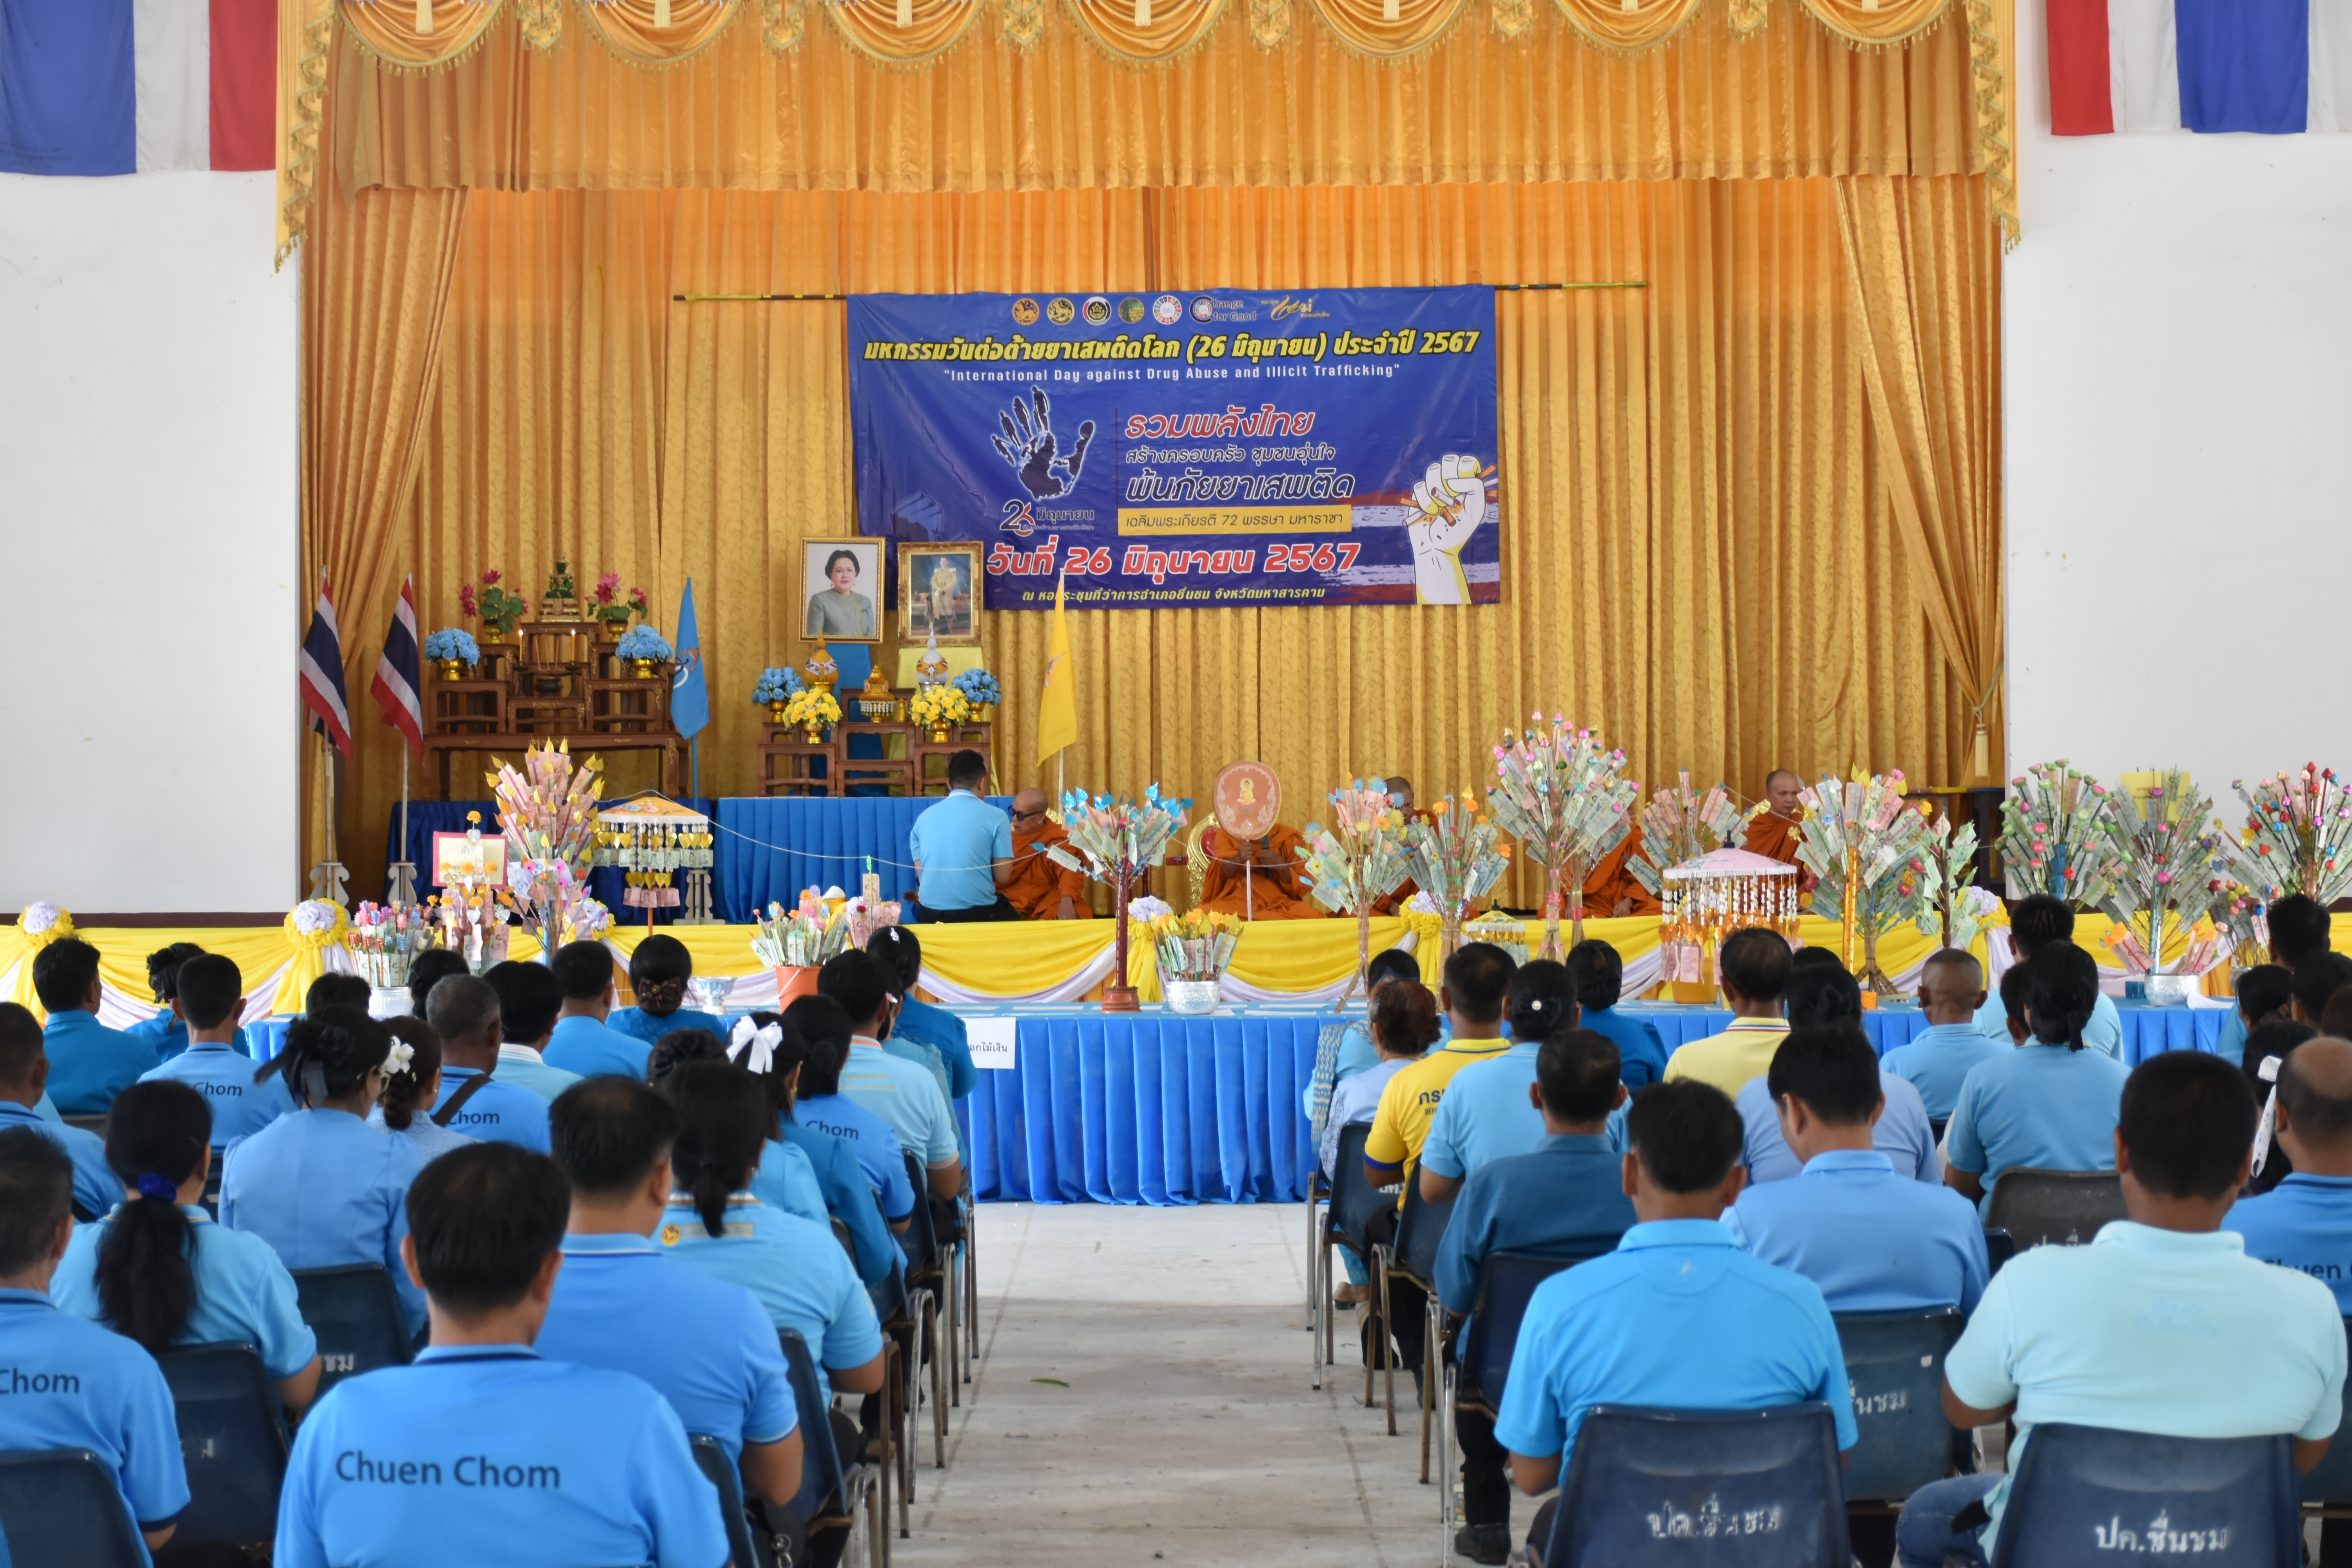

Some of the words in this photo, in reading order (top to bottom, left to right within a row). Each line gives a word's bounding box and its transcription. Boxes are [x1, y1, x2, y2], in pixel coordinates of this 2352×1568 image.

[1230, 311, 1256, 321] Good
[1187, 335, 1228, 364] (26
[1232, 332, 1327, 363] มิถุนายน)
[1334, 330, 1417, 355] ประจำปี
[1419, 331, 1481, 353] 2567
[944, 370, 1047, 381] "International
[1055, 370, 1079, 382] Day
[1087, 370, 1140, 382] against
[1147, 368, 1179, 381] Drug
[1186, 368, 1228, 379] Abuse
[1235, 367, 1259, 377] and
[1267, 366, 1307, 377] Illicit
[1314, 364, 1399, 377] Trafficking"
[1125, 403, 1316, 439] รวมพลังไทย
[1126, 445, 1246, 463] สร้างครอบครัว
[1251, 442, 1336, 466] ชุมชนอุ่นใจ
[1126, 467, 1356, 501] พ้นภัยยาเสพติด
[1036, 507, 1094, 524] มิถุนายน
[1126, 514, 1216, 528] เฉลิมพระเกียรติ
[1222, 515, 1238, 526] 72
[1243, 515, 1284, 525] พรรษา
[1289, 514, 1343, 524] มหาราชา
[987, 535, 1059, 575] วันที่
[1064, 547, 1112, 575] 26
[1121, 544, 1256, 584] มิถุนายน
[1263, 543, 1361, 573] 2567
[1039, 587, 1210, 603] หอระชุมที่ว่าการอำเภอชื่นชม
[1215, 587, 1326, 599] จังหวัดมหาสารคาม
[969, 1041, 1008, 1053] อกไม้เงิน
[336, 1450, 441, 1485] Chuen
[454, 1456, 560, 1489] Chom
